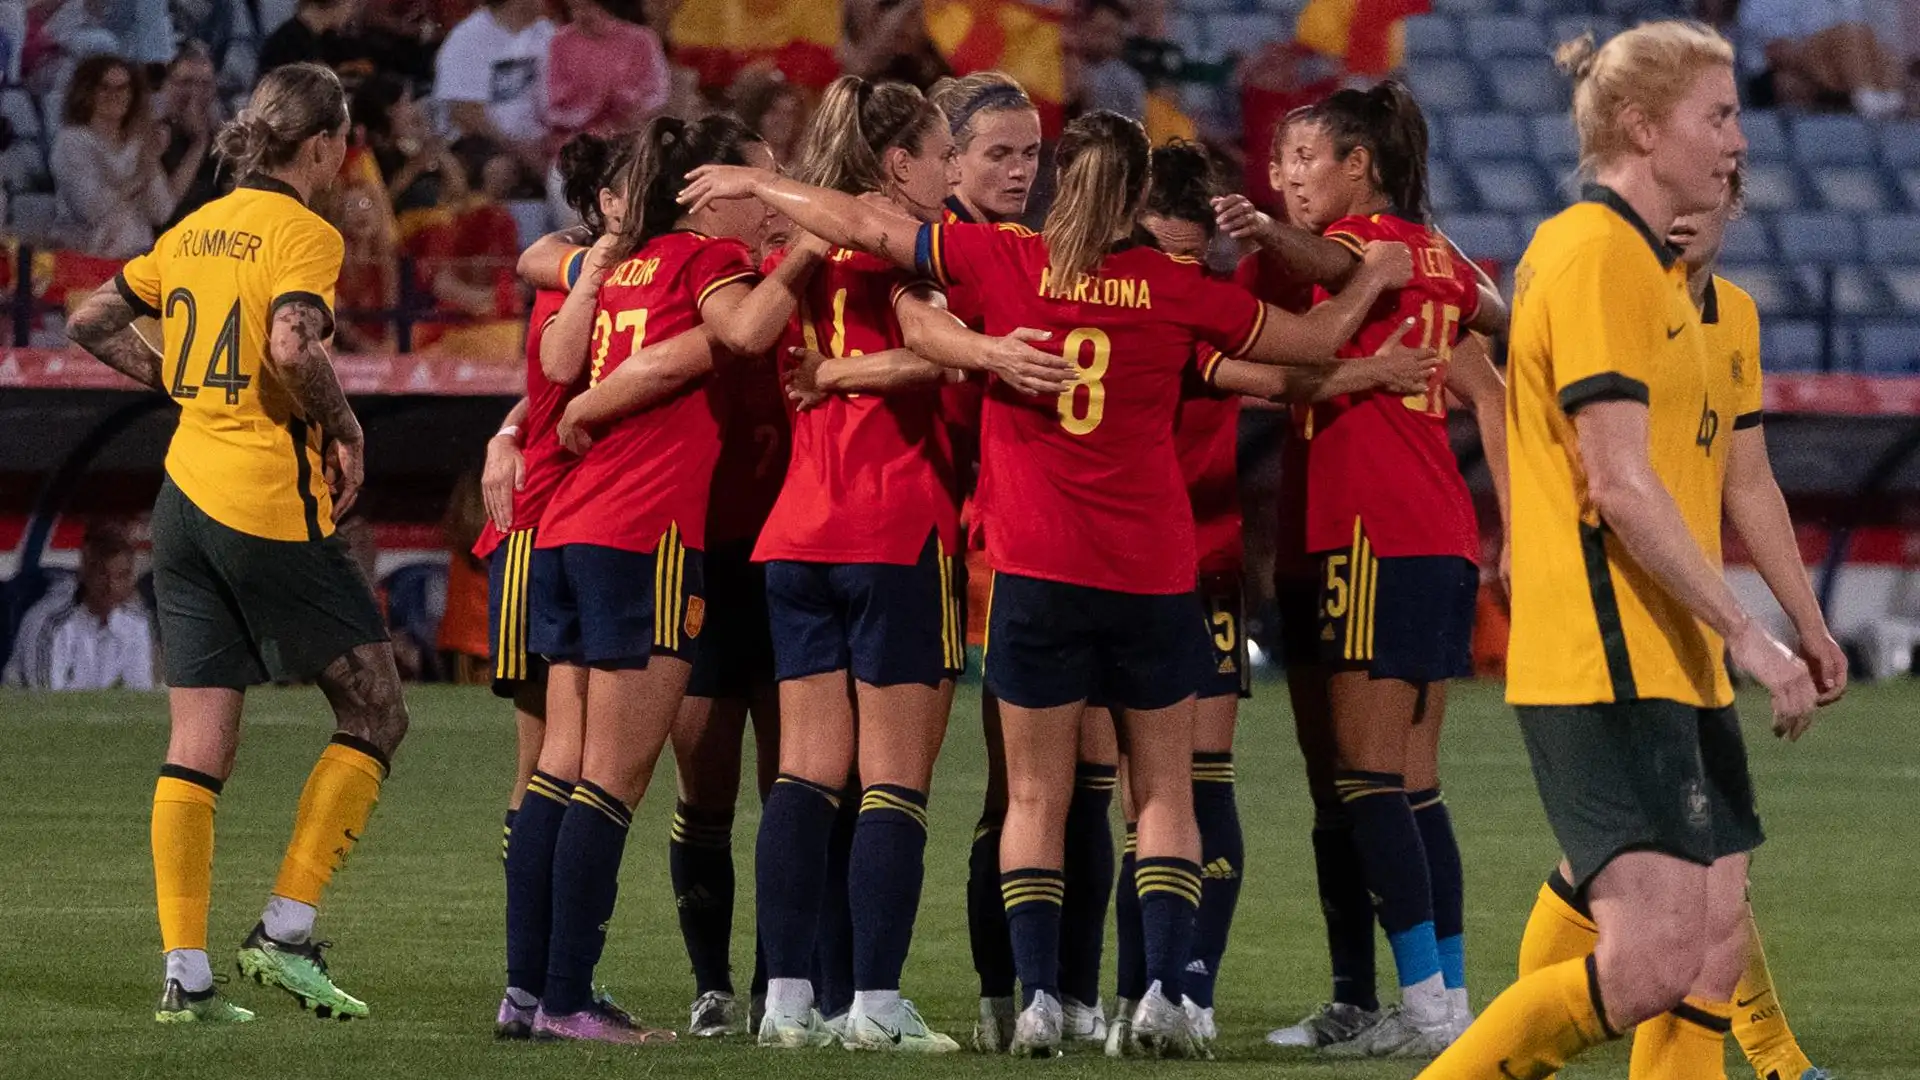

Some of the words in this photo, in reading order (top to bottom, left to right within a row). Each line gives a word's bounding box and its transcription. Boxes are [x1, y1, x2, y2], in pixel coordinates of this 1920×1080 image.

[165, 287, 252, 405] 24
[1057, 327, 1112, 436] 8
[1327, 555, 1348, 618] 5
